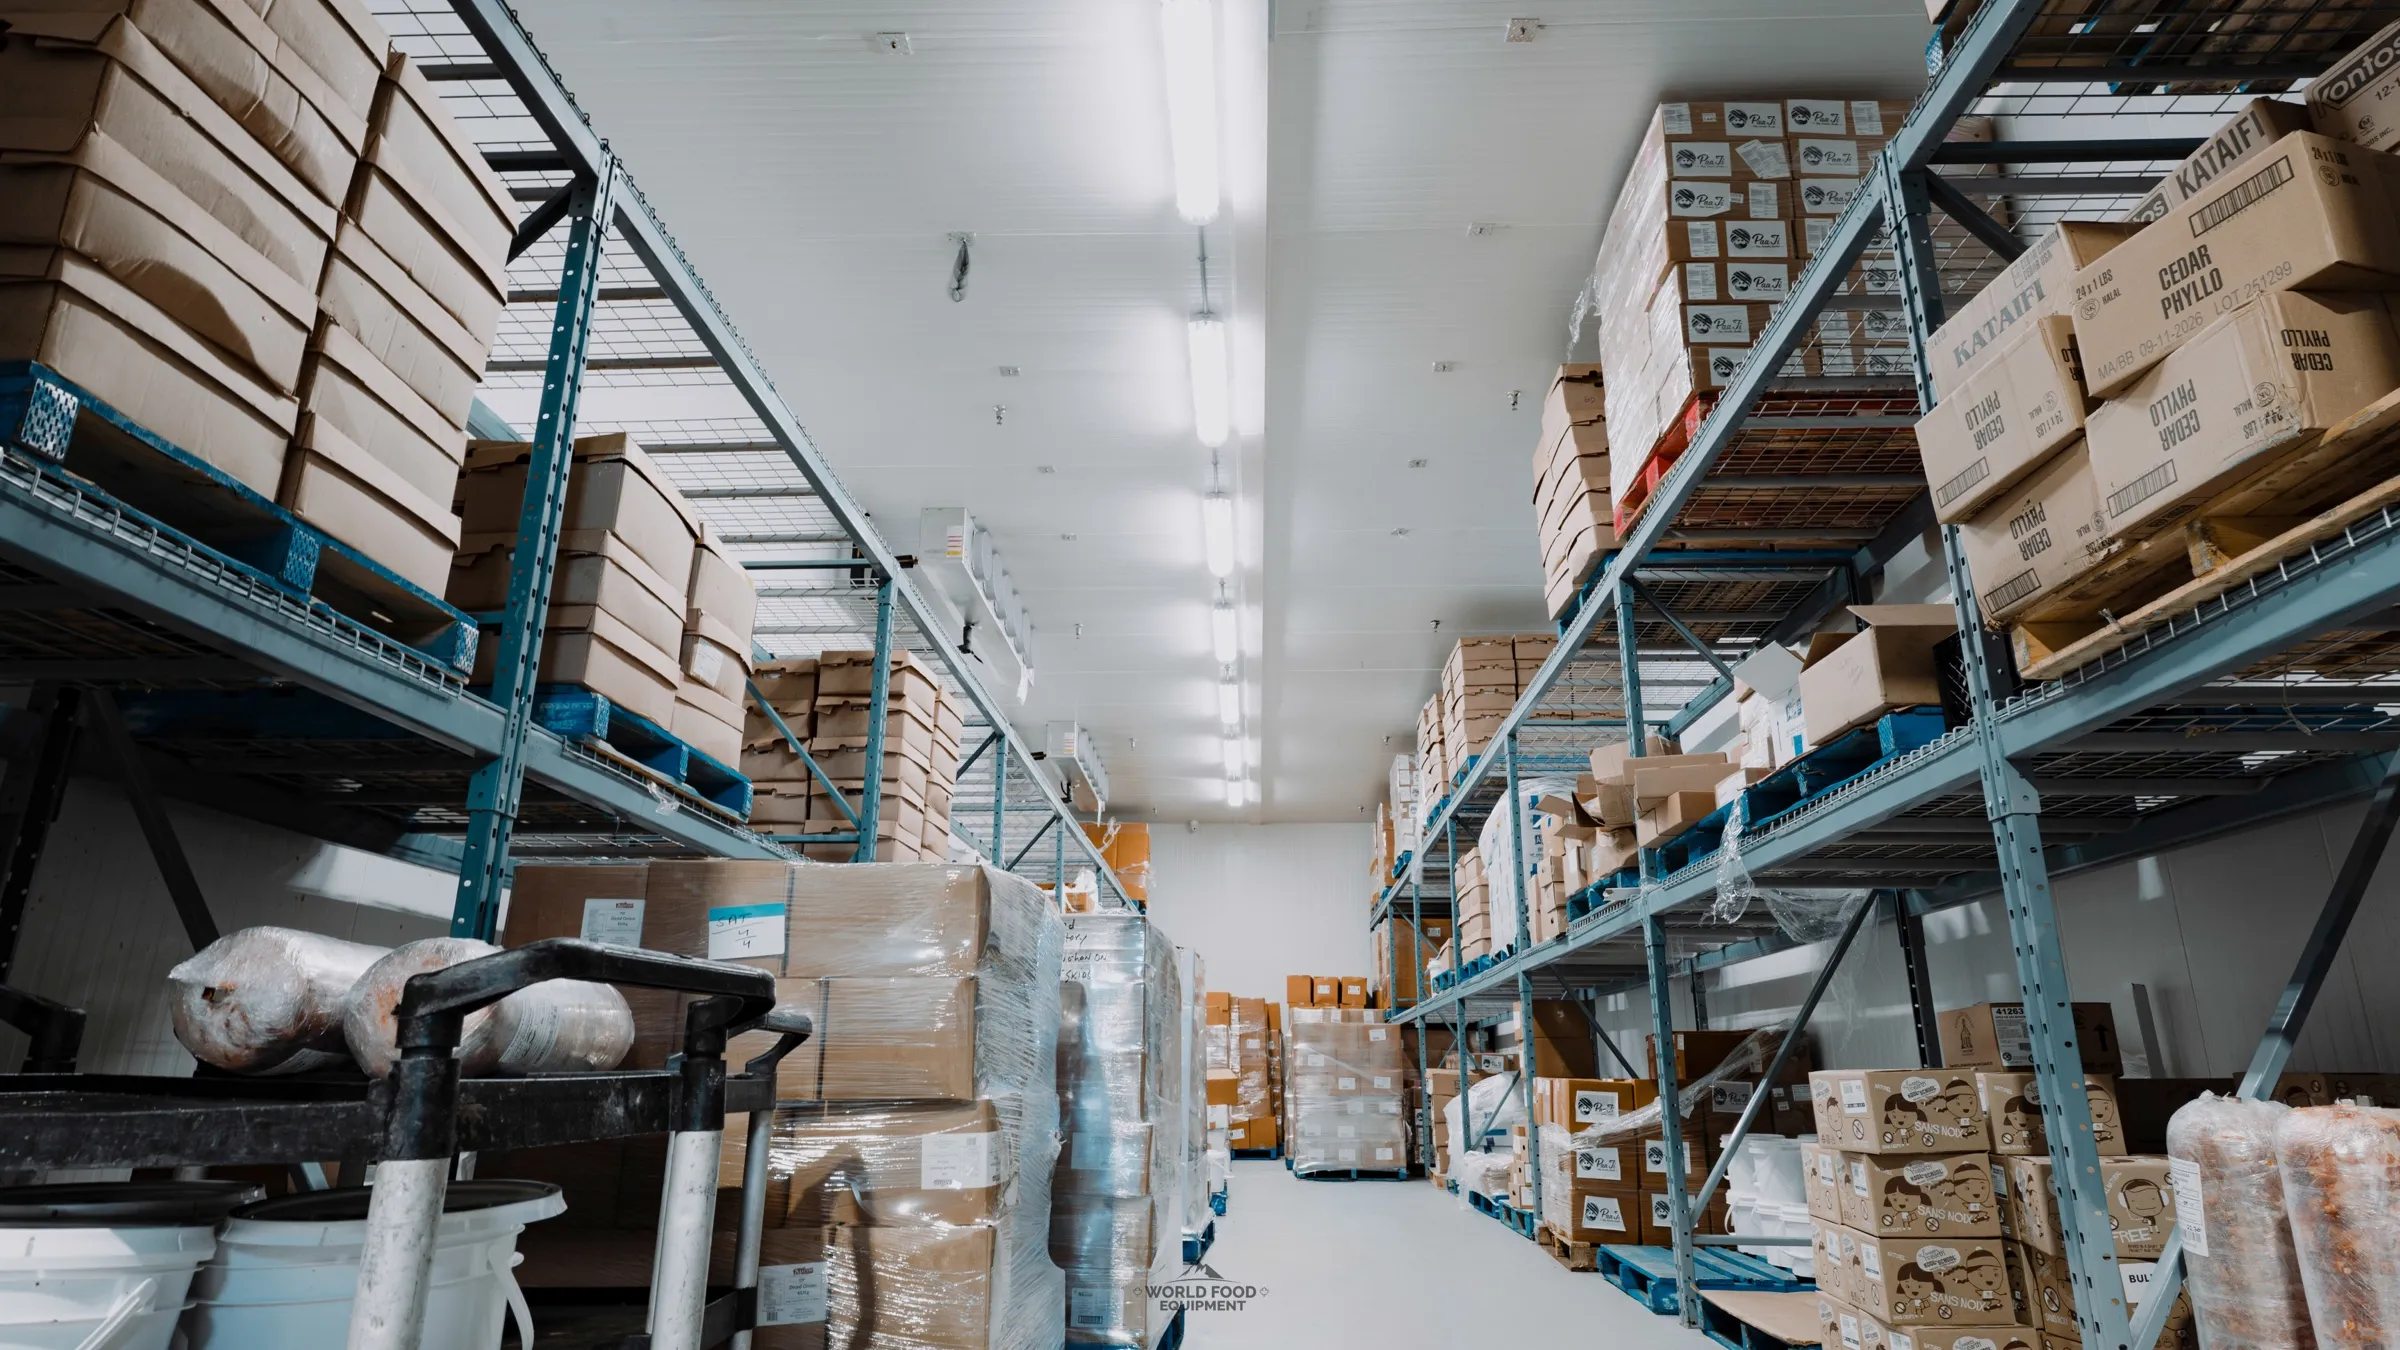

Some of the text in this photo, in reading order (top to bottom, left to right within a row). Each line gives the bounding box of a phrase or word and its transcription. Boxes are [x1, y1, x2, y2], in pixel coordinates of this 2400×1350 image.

[2176, 111, 2265, 200] KATAIFI
[2076, 287, 2086, 300] 24
[2098, 269, 2113, 287] LBS
[2158, 244, 2212, 291] CEDAR
[2102, 287, 2122, 305] HALAL
[2160, 267, 2223, 320] PHYLLO
[1952, 280, 2047, 368] KATAIFI
[2097, 351, 2135, 380] MA/BB
[2139, 312, 2204, 357] 09-11-2026
[2213, 288, 2239, 316] LOT
[2243, 260, 2293, 299] 251299
[2280, 328, 2331, 348] PHYLLO
[2291, 352, 2334, 371] CEDAR
[1965, 390, 2001, 430] PHYLLO
[2149, 378, 2197, 427] PHYLLO
[1973, 415, 2005, 450] CEDAR
[2158, 408, 2200, 452] CEDAR
[2009, 501, 2046, 539] PHYLLO
[2018, 527, 2052, 561] CEDAR
[717, 912, 752, 928] SAT
[1914, 1121, 1964, 1139] SANS NOIX
[1917, 1205, 1974, 1225] SANS NOIX
[2129, 1274, 2153, 1284] BUL
[1930, 1291, 1987, 1312] SANS NOIX
